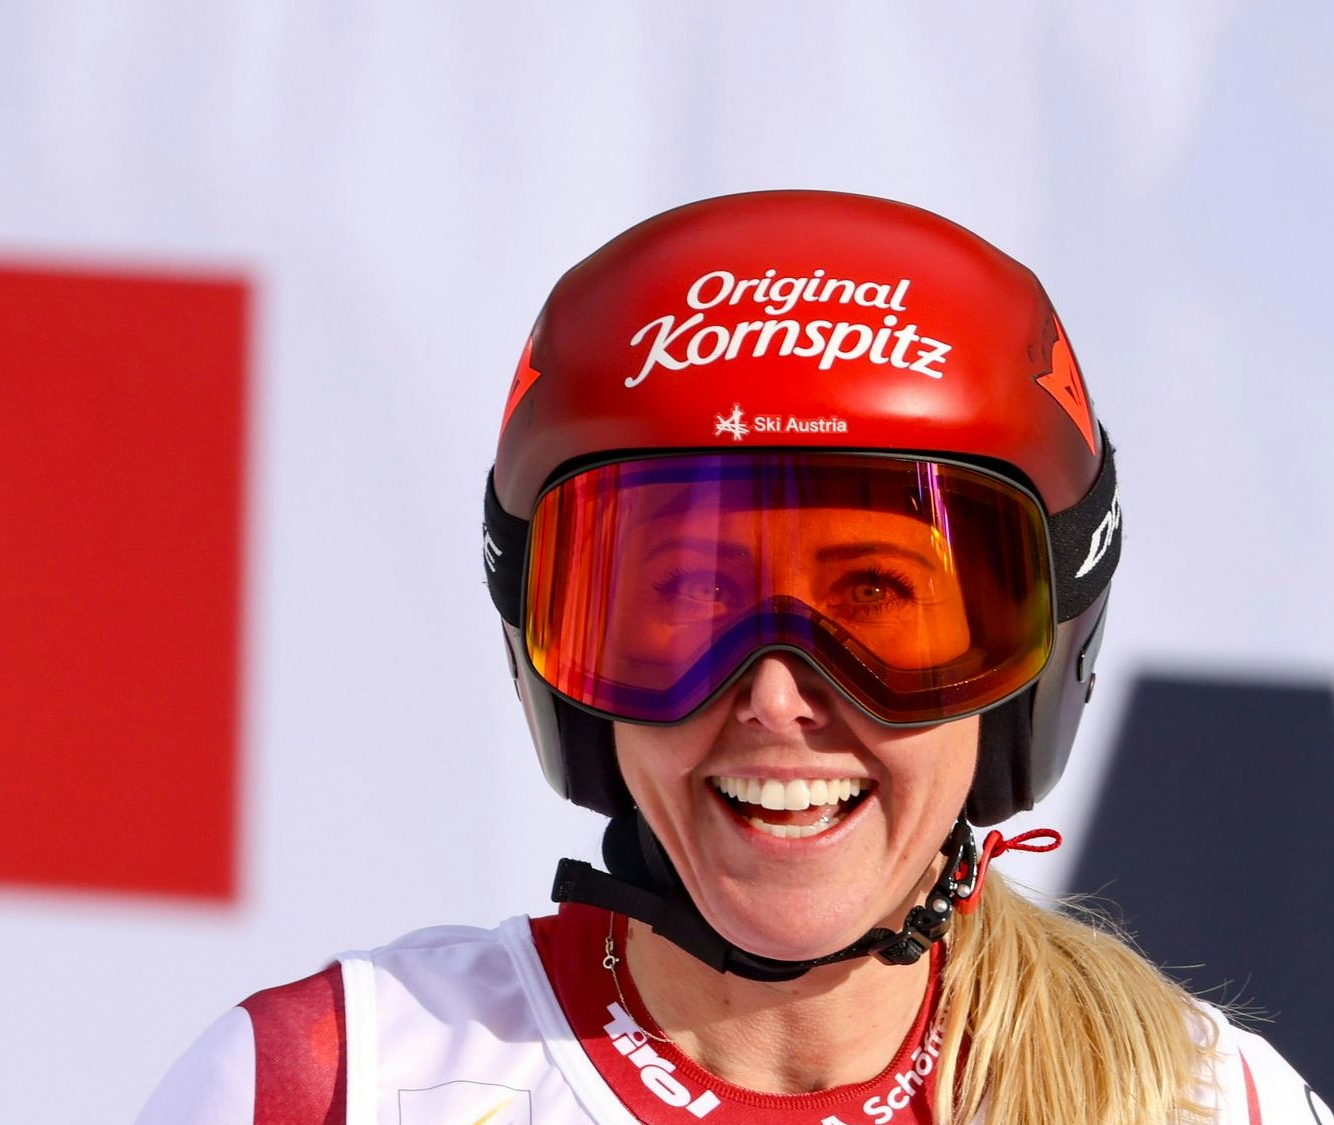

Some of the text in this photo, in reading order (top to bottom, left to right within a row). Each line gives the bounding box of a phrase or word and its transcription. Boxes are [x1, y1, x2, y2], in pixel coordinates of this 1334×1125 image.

[686, 268, 911, 316] Original
[624, 311, 953, 388] Kornspitz
[754, 416, 847, 433] Ski Austria
[603, 1001, 722, 1119] Tirol
